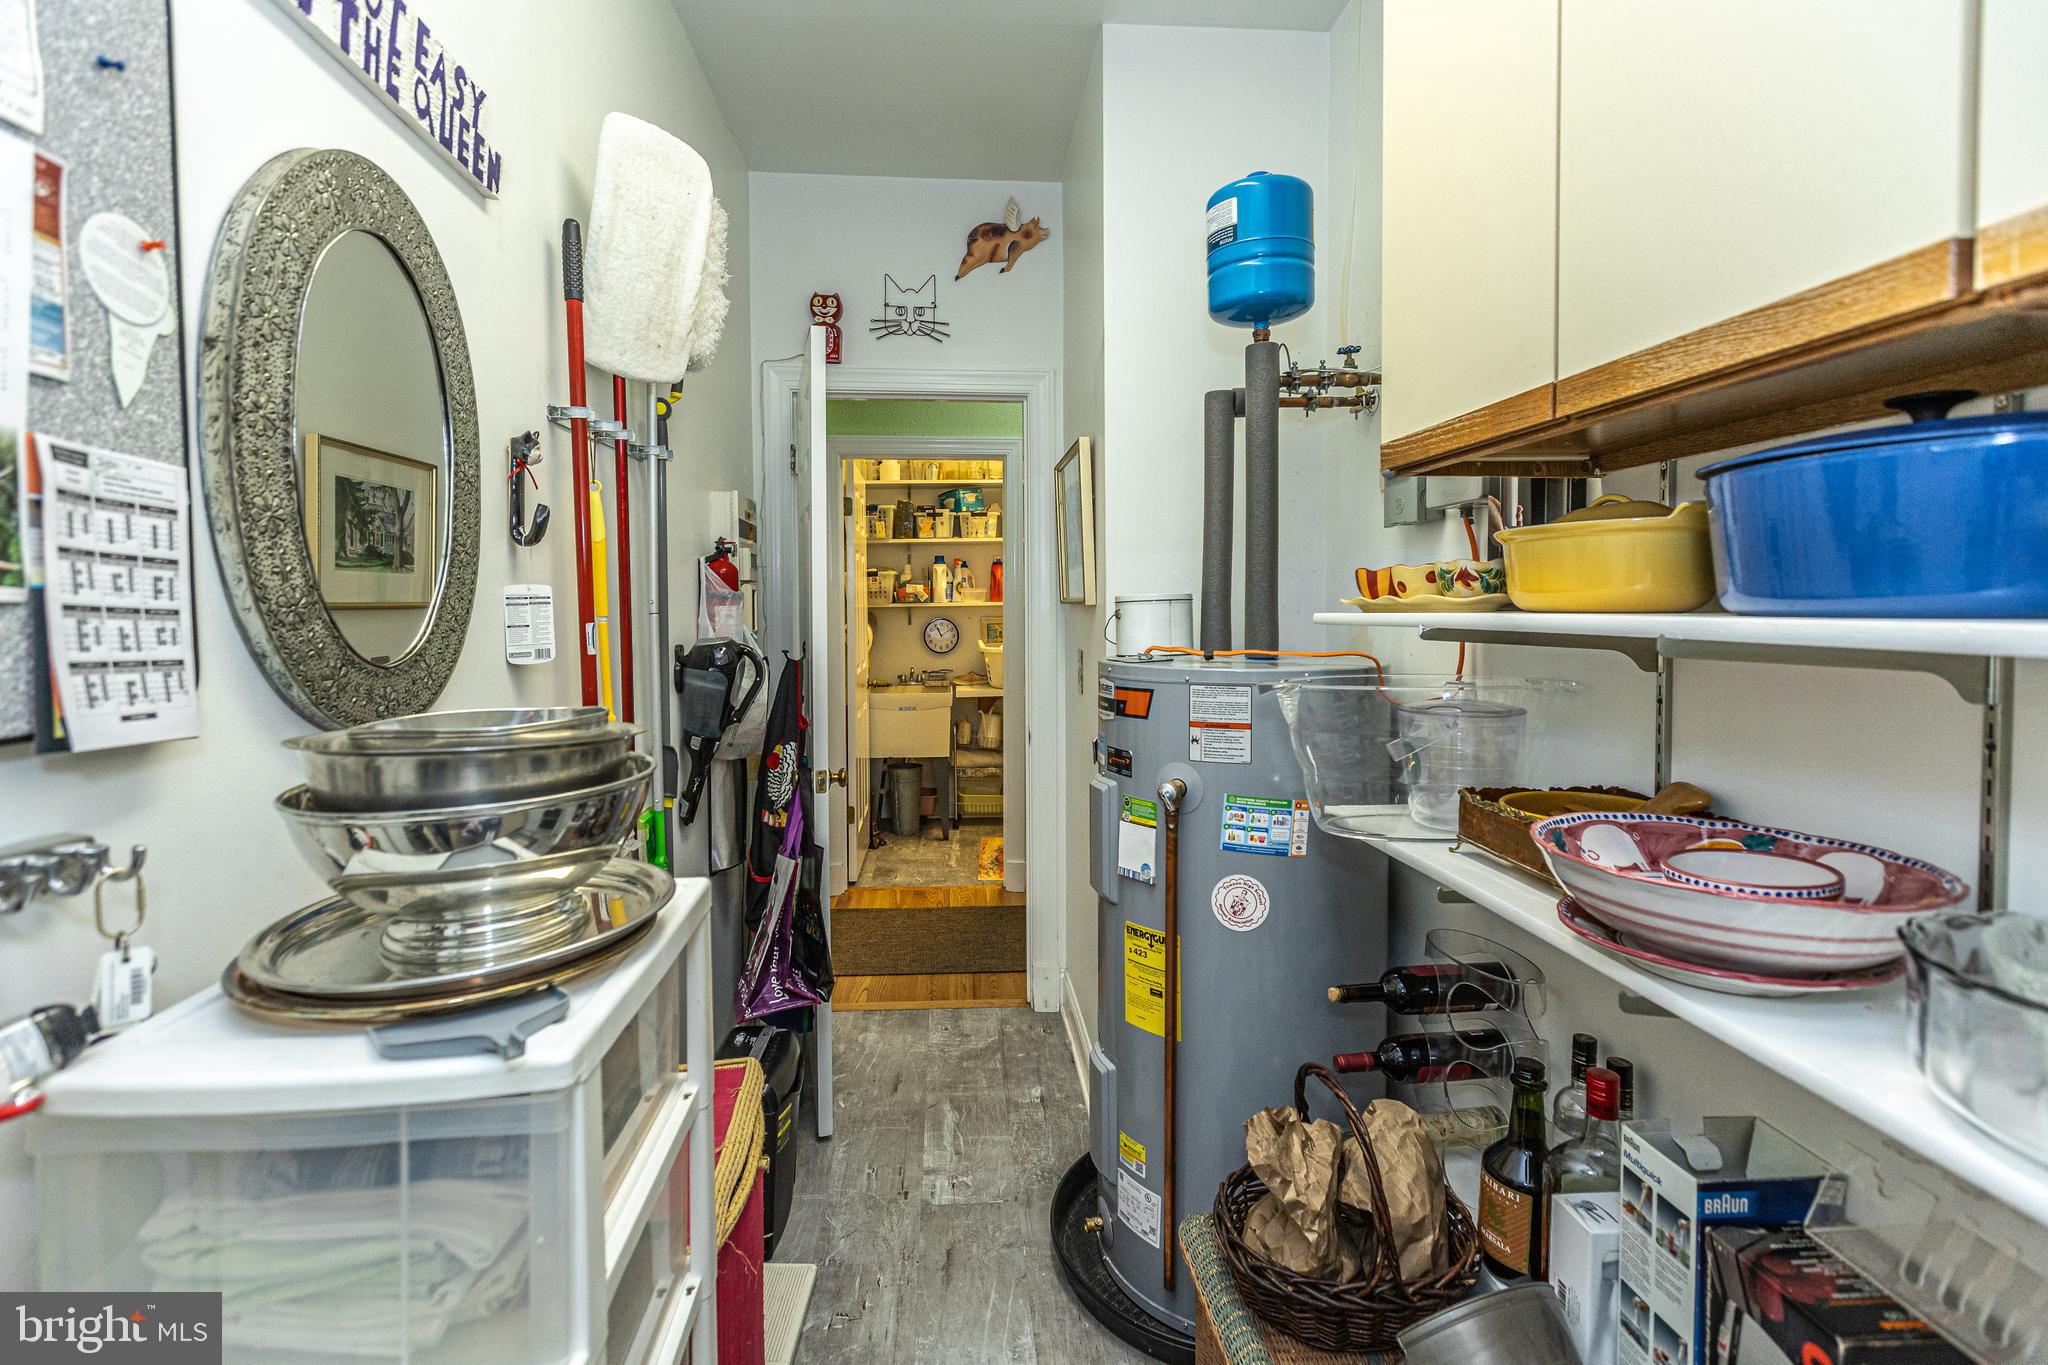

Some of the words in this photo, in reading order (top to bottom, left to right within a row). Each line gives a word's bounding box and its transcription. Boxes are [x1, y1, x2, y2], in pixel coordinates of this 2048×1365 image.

[415, 17, 487, 132] EASY
[338, 0, 401, 104] THE
[414, 76, 502, 194] QUEEN
[1126, 925, 1165, 945] ENERGYGU
[1133, 948, 1148, 959] 423
[769, 977, 790, 1005] Love
[1623, 1149, 1663, 1187] Multiquick
[1704, 1193, 1749, 1215] BRAUN
[1481, 1226, 1512, 1254] MARSALA
